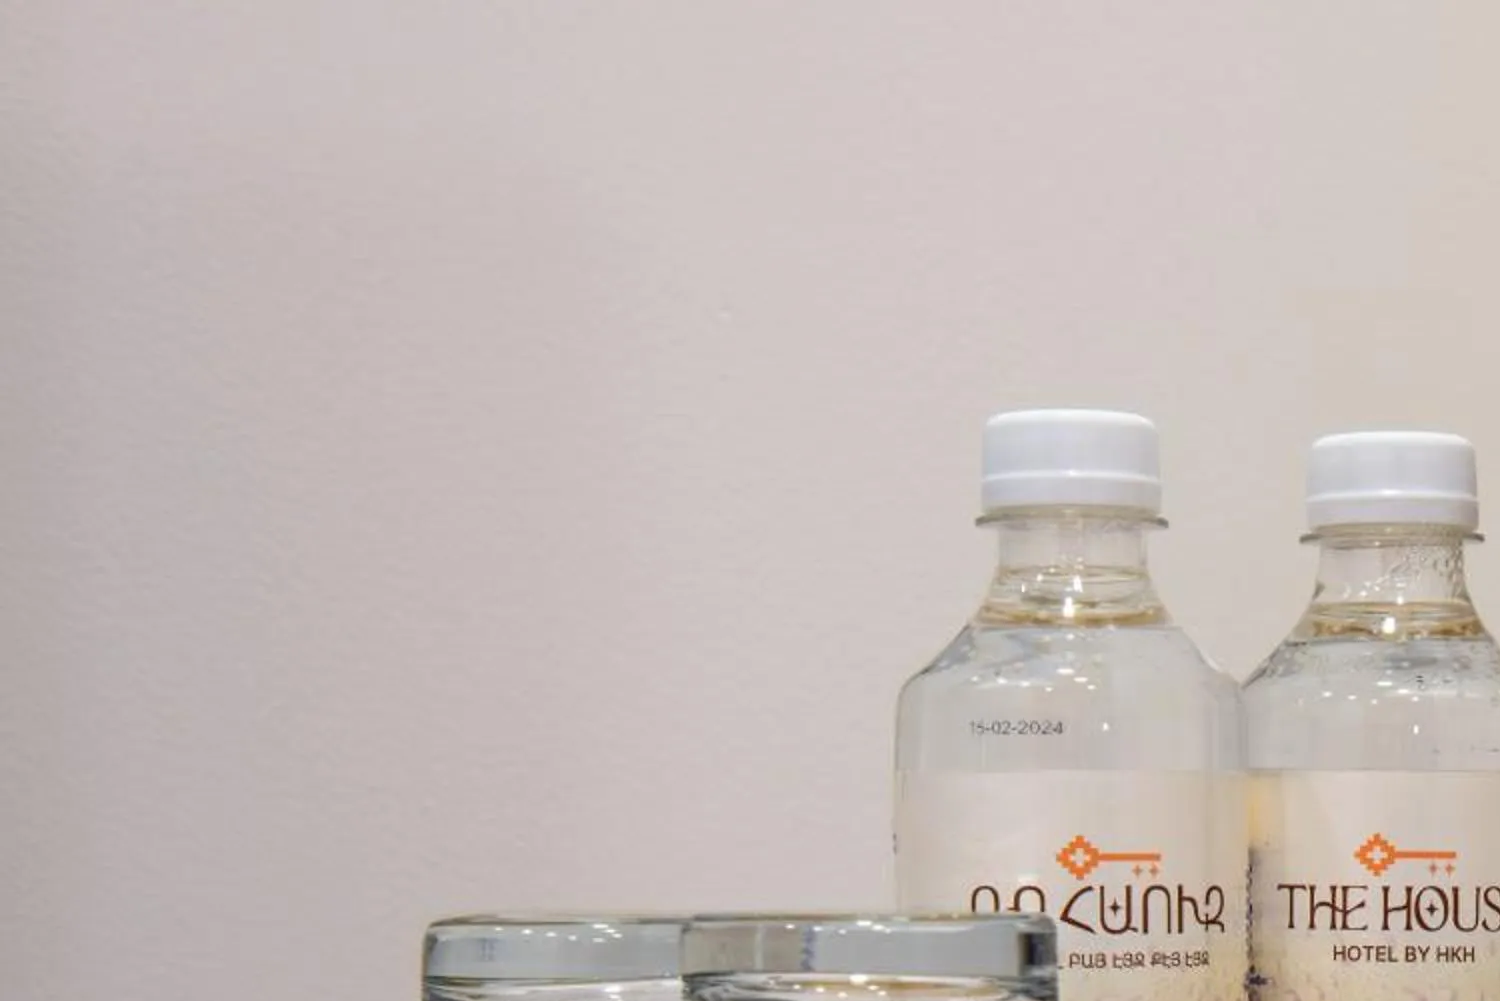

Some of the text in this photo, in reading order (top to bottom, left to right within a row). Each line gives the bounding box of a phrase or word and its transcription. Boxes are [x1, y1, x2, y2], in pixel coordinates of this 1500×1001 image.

[1277, 884, 1369, 931] THE
[1332, 945, 1476, 963] HOTEL BY HKH
